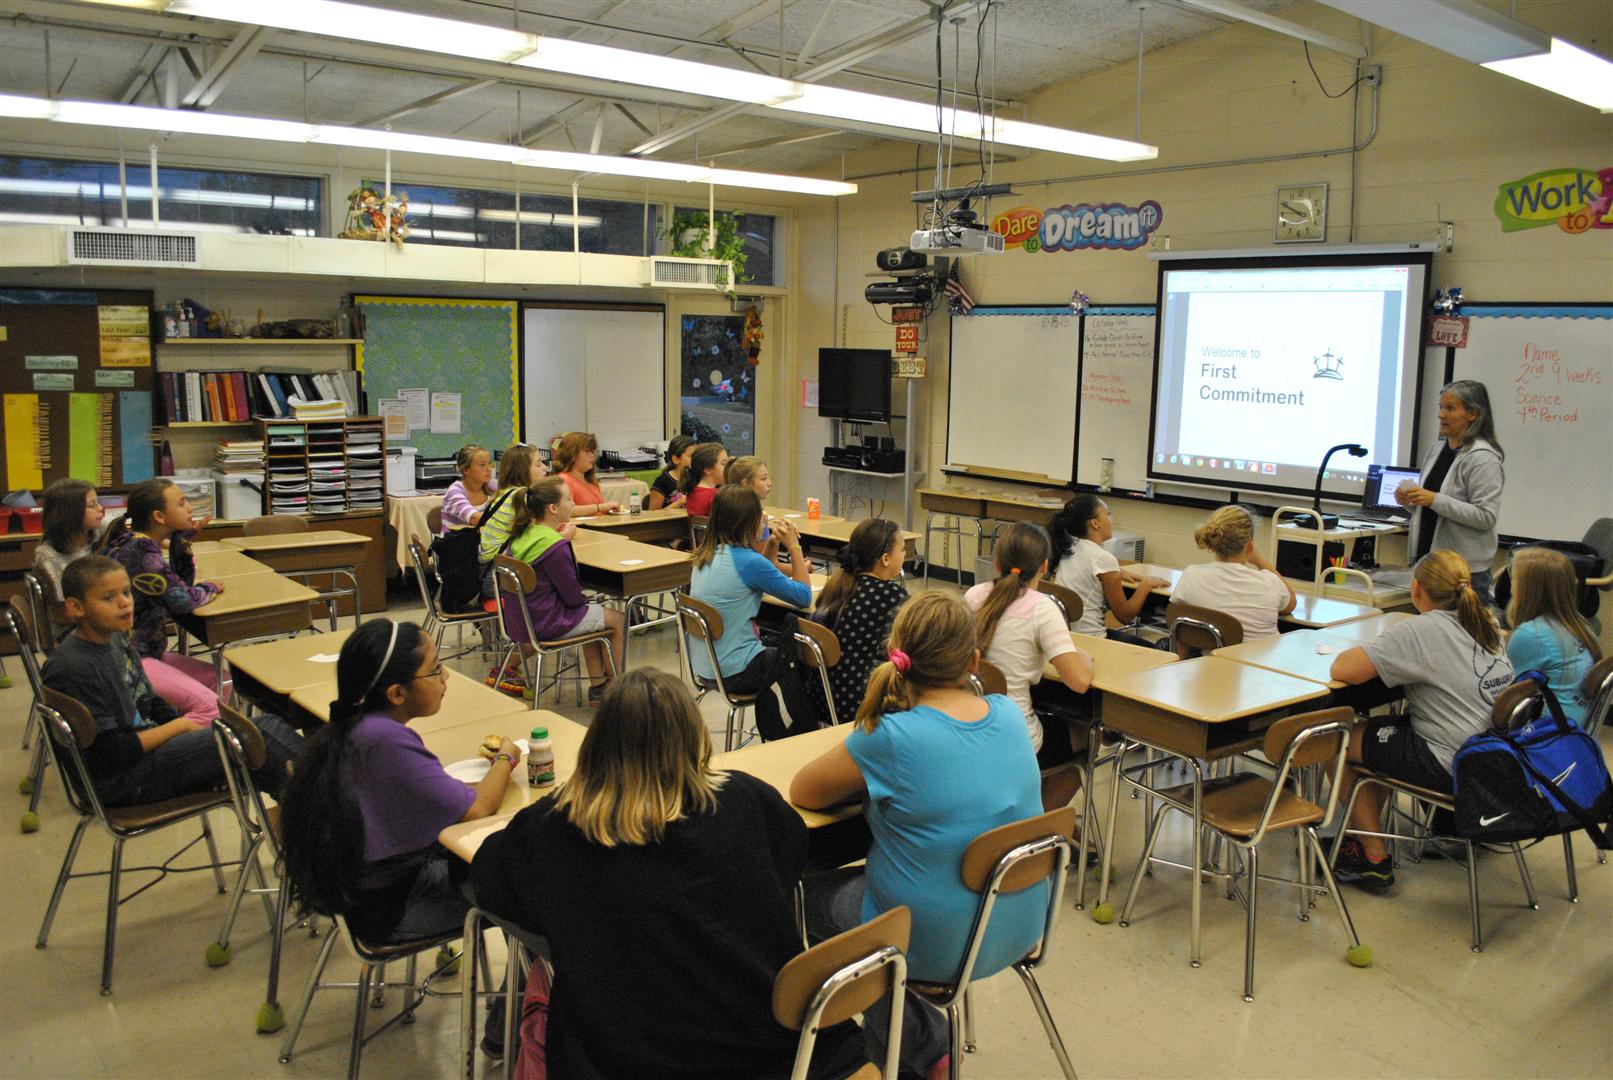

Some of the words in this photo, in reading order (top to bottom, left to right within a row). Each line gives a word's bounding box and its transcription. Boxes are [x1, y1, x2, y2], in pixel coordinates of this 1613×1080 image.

[1507, 172, 1597, 216] Work
[1566, 211, 1588, 230] to
[998, 214, 1038, 238] Dare
[1026, 238, 1038, 250] to
[1044, 211, 1141, 247] Dream
[900, 329, 914, 339] DO
[896, 341, 917, 349] YOUR
[1201, 346, 1248, 358] Welcome
[1250, 348, 1261, 359] to
[1201, 363, 1237, 379] First
[1199, 385, 1305, 406] Commitment
[1516, 386, 1562, 405] Science
